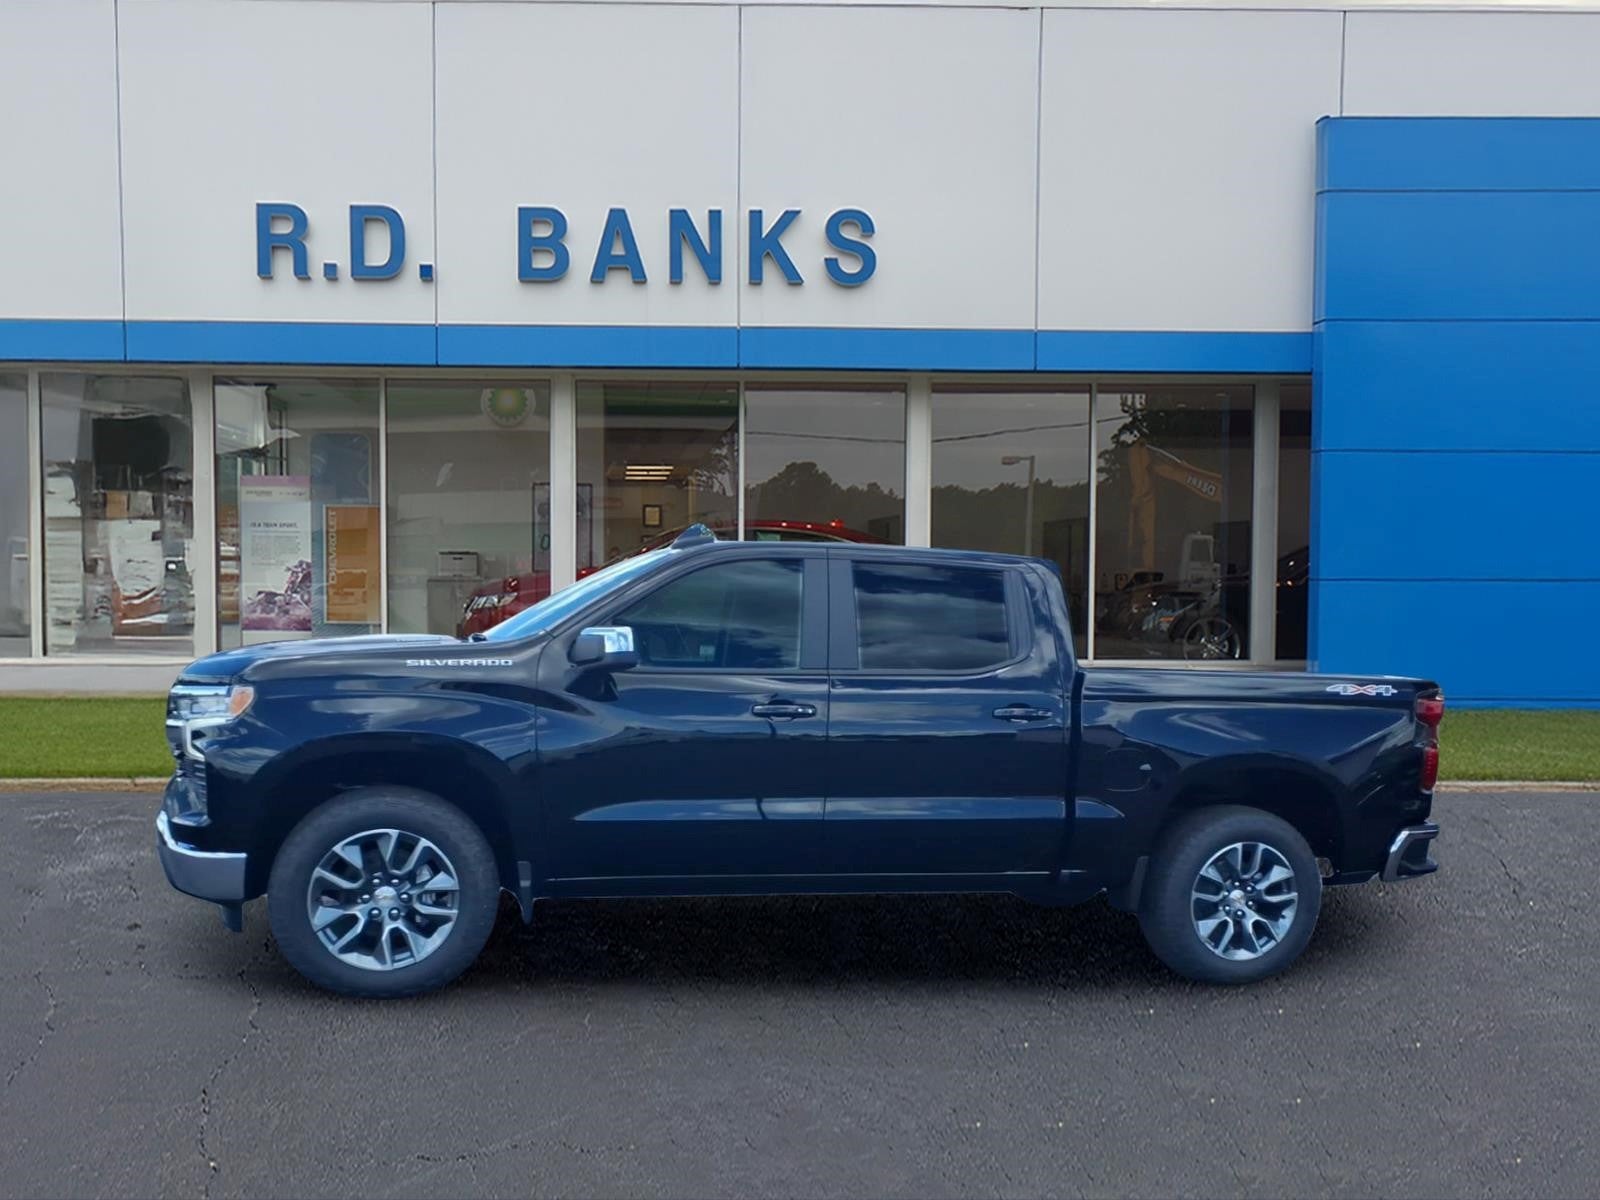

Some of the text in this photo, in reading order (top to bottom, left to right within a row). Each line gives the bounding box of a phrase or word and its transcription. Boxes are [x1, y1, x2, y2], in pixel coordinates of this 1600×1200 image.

[256, 202, 878, 286] R.D. BANKS
[328, 510, 337, 584] CHEVROLET
[406, 659, 513, 667] SILVERADO
